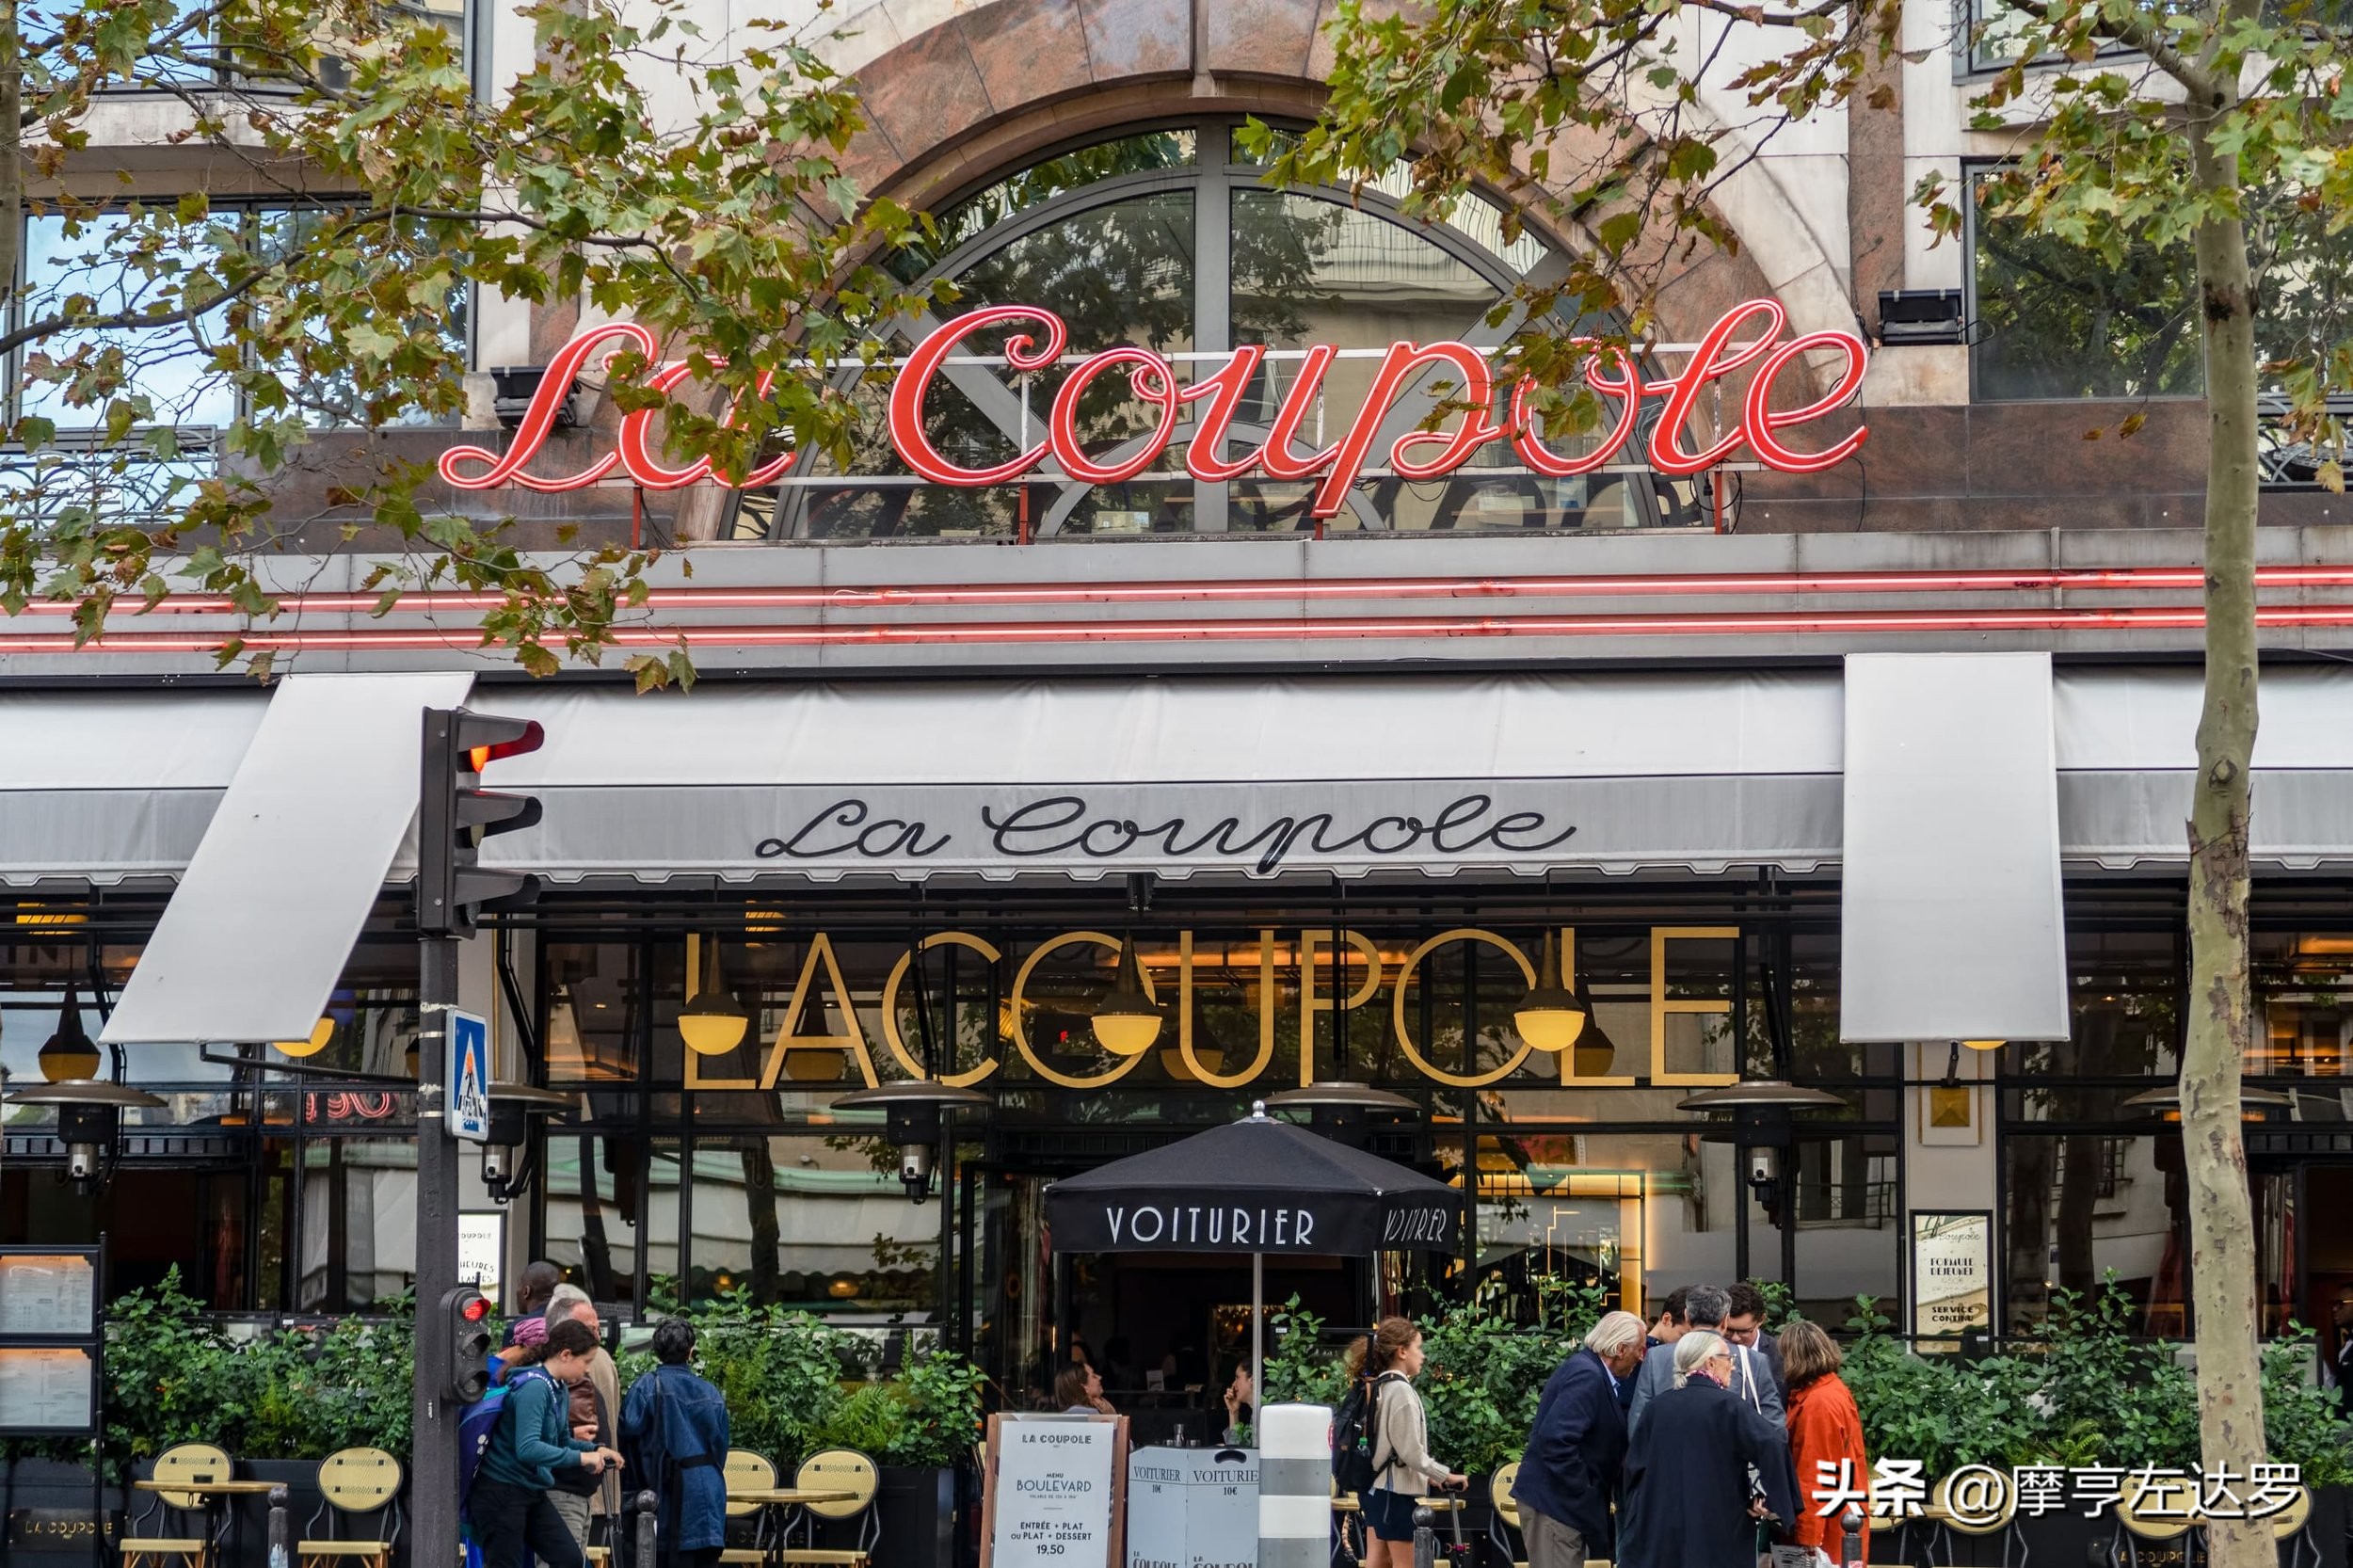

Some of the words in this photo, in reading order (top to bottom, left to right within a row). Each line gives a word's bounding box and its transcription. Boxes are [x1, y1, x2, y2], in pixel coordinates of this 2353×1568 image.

[888, 297, 1870, 520] Coupole
[756, 798, 951, 858] La
[981, 793, 1578, 874] Coupole
[1106, 1206, 1314, 1245] VOITURIER
[1930, 1257, 1974, 1267] FORMULE
[1931, 1305, 1975, 1314] SERVICE
[1022, 1434, 1036, 1444] LA
[1040, 1434, 1092, 1445] COUPOLE
[1133, 1466, 1181, 1482] VOITURIER
[1193, 1470, 1259, 1482] VOITURIE
[1016, 1480, 1092, 1493] BOULEVARD
[1224, 1486, 1238, 1496] 10€
[47, 1521, 113, 1535] COUPOE
[1020, 1520, 1050, 1530] ENTRÉE
[1062, 1522, 1083, 1530] PLAT
[1022, 1531, 1044, 1540] PLAT
[1055, 1532, 1092, 1541] DESSERT
